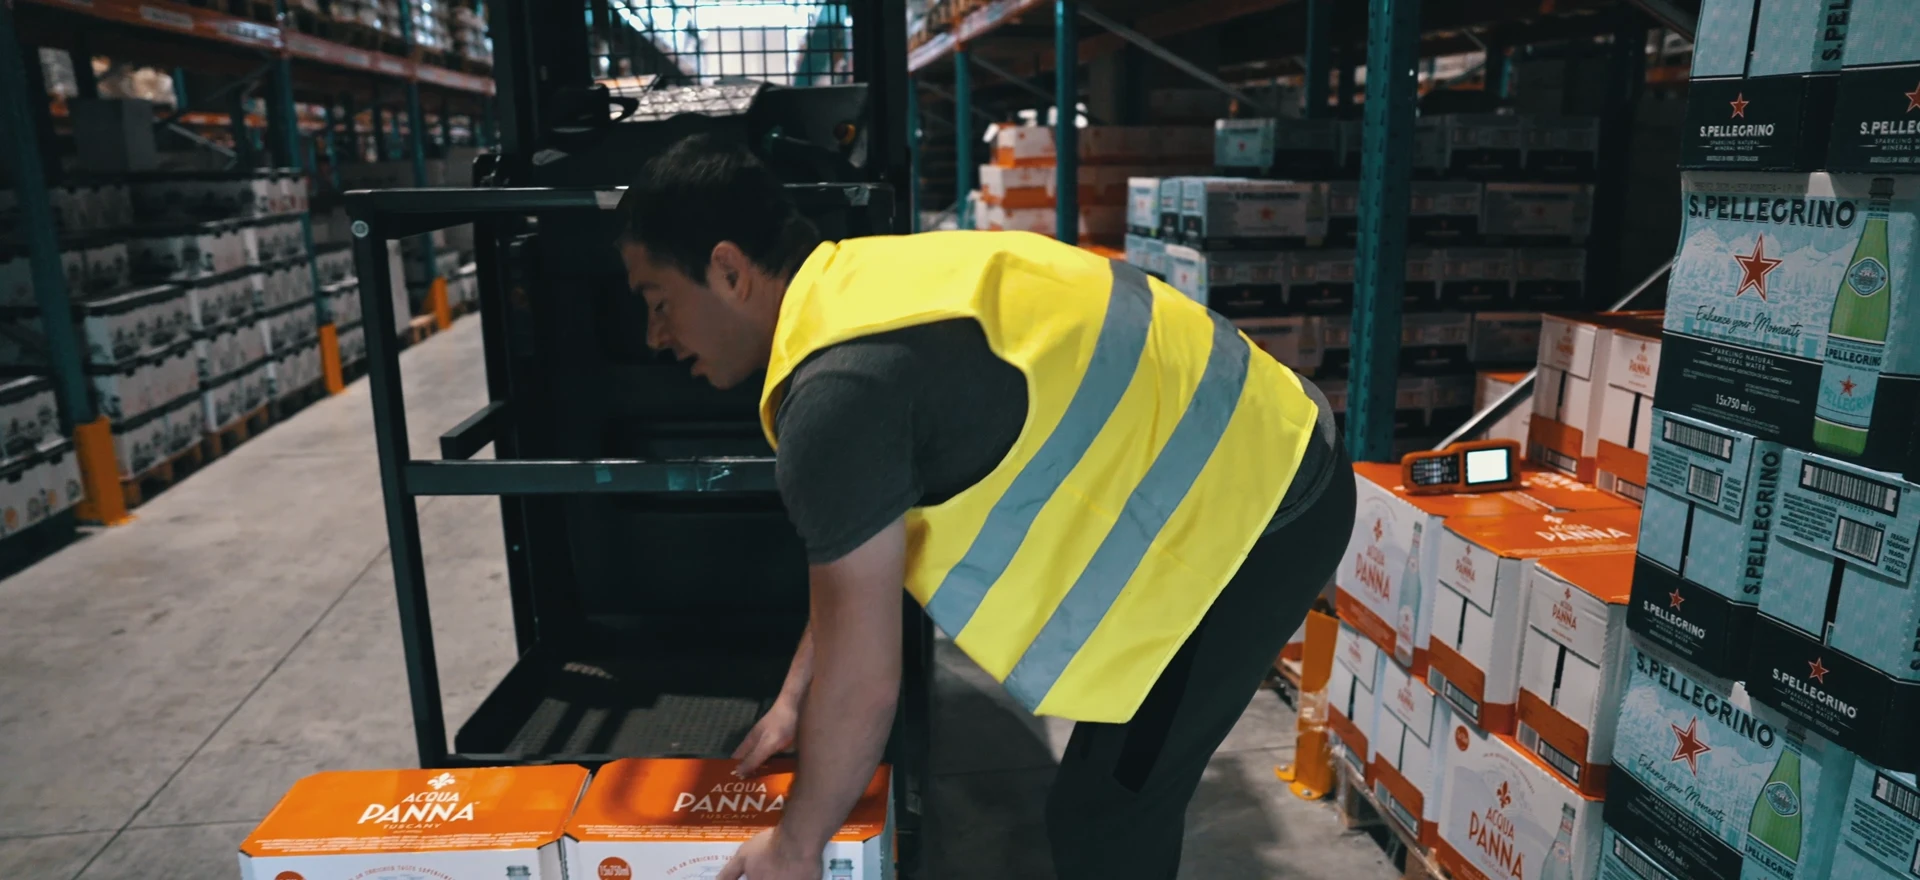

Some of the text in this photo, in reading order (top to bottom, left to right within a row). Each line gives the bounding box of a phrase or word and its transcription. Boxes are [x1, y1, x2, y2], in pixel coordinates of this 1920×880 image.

[1700, 124, 1774, 137] S.PELLEGRINO
[1689, 194, 1857, 229] S.PELLEGRINO
[1752, 312, 1803, 338] Moments
[1745, 352, 1774, 366] NATURAL
[1745, 360, 1766, 371] WATER
[1743, 450, 1780, 595] S.PELLEGRINO
[1355, 552, 1391, 602] PANNA
[1643, 600, 1705, 639] S.PELLEGRINO
[1637, 652, 1775, 748] S.PELLEGRINO
[1772, 668, 1857, 718] S.PELLEGRINO
[401, 791, 459, 803] ACQUA
[673, 792, 785, 812] PANNA
[711, 782, 767, 793] ACQUA
[1685, 785, 1726, 823] Moments
[357, 802, 475, 824] PANNA
[1485, 806, 1515, 840] ACQUA
[1469, 811, 1523, 880] PANNA
